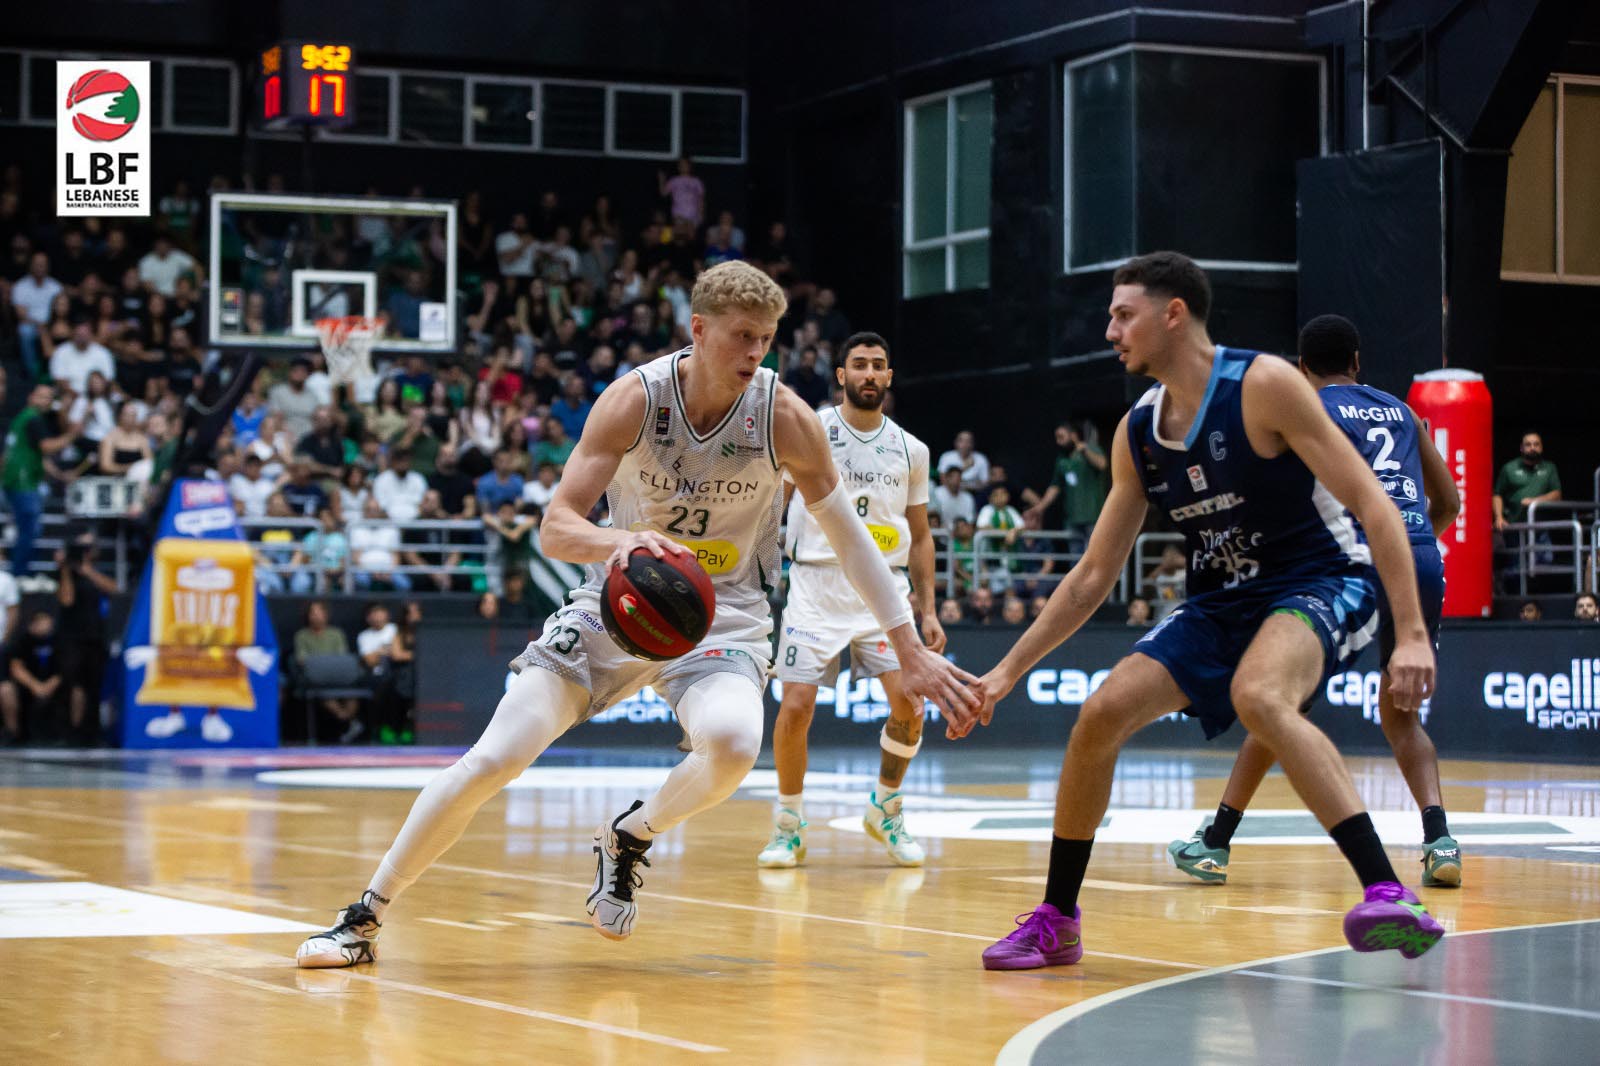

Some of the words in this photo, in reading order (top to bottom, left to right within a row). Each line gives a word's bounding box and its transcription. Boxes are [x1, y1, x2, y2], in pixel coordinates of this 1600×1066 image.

[310, 74, 345, 116] 17
[1338, 405, 1404, 422] McGill
[1208, 430, 1227, 461] C
[1366, 427, 1401, 470] 2
[640, 470, 759, 495] ELLINGTON
[857, 496, 869, 517] 8
[666, 505, 710, 537] 23
[872, 531, 894, 545] Pay
[696, 549, 729, 568] Pay
[545, 625, 580, 655] 23
[785, 645, 797, 666] 8
[1484, 658, 1600, 724] capelli
